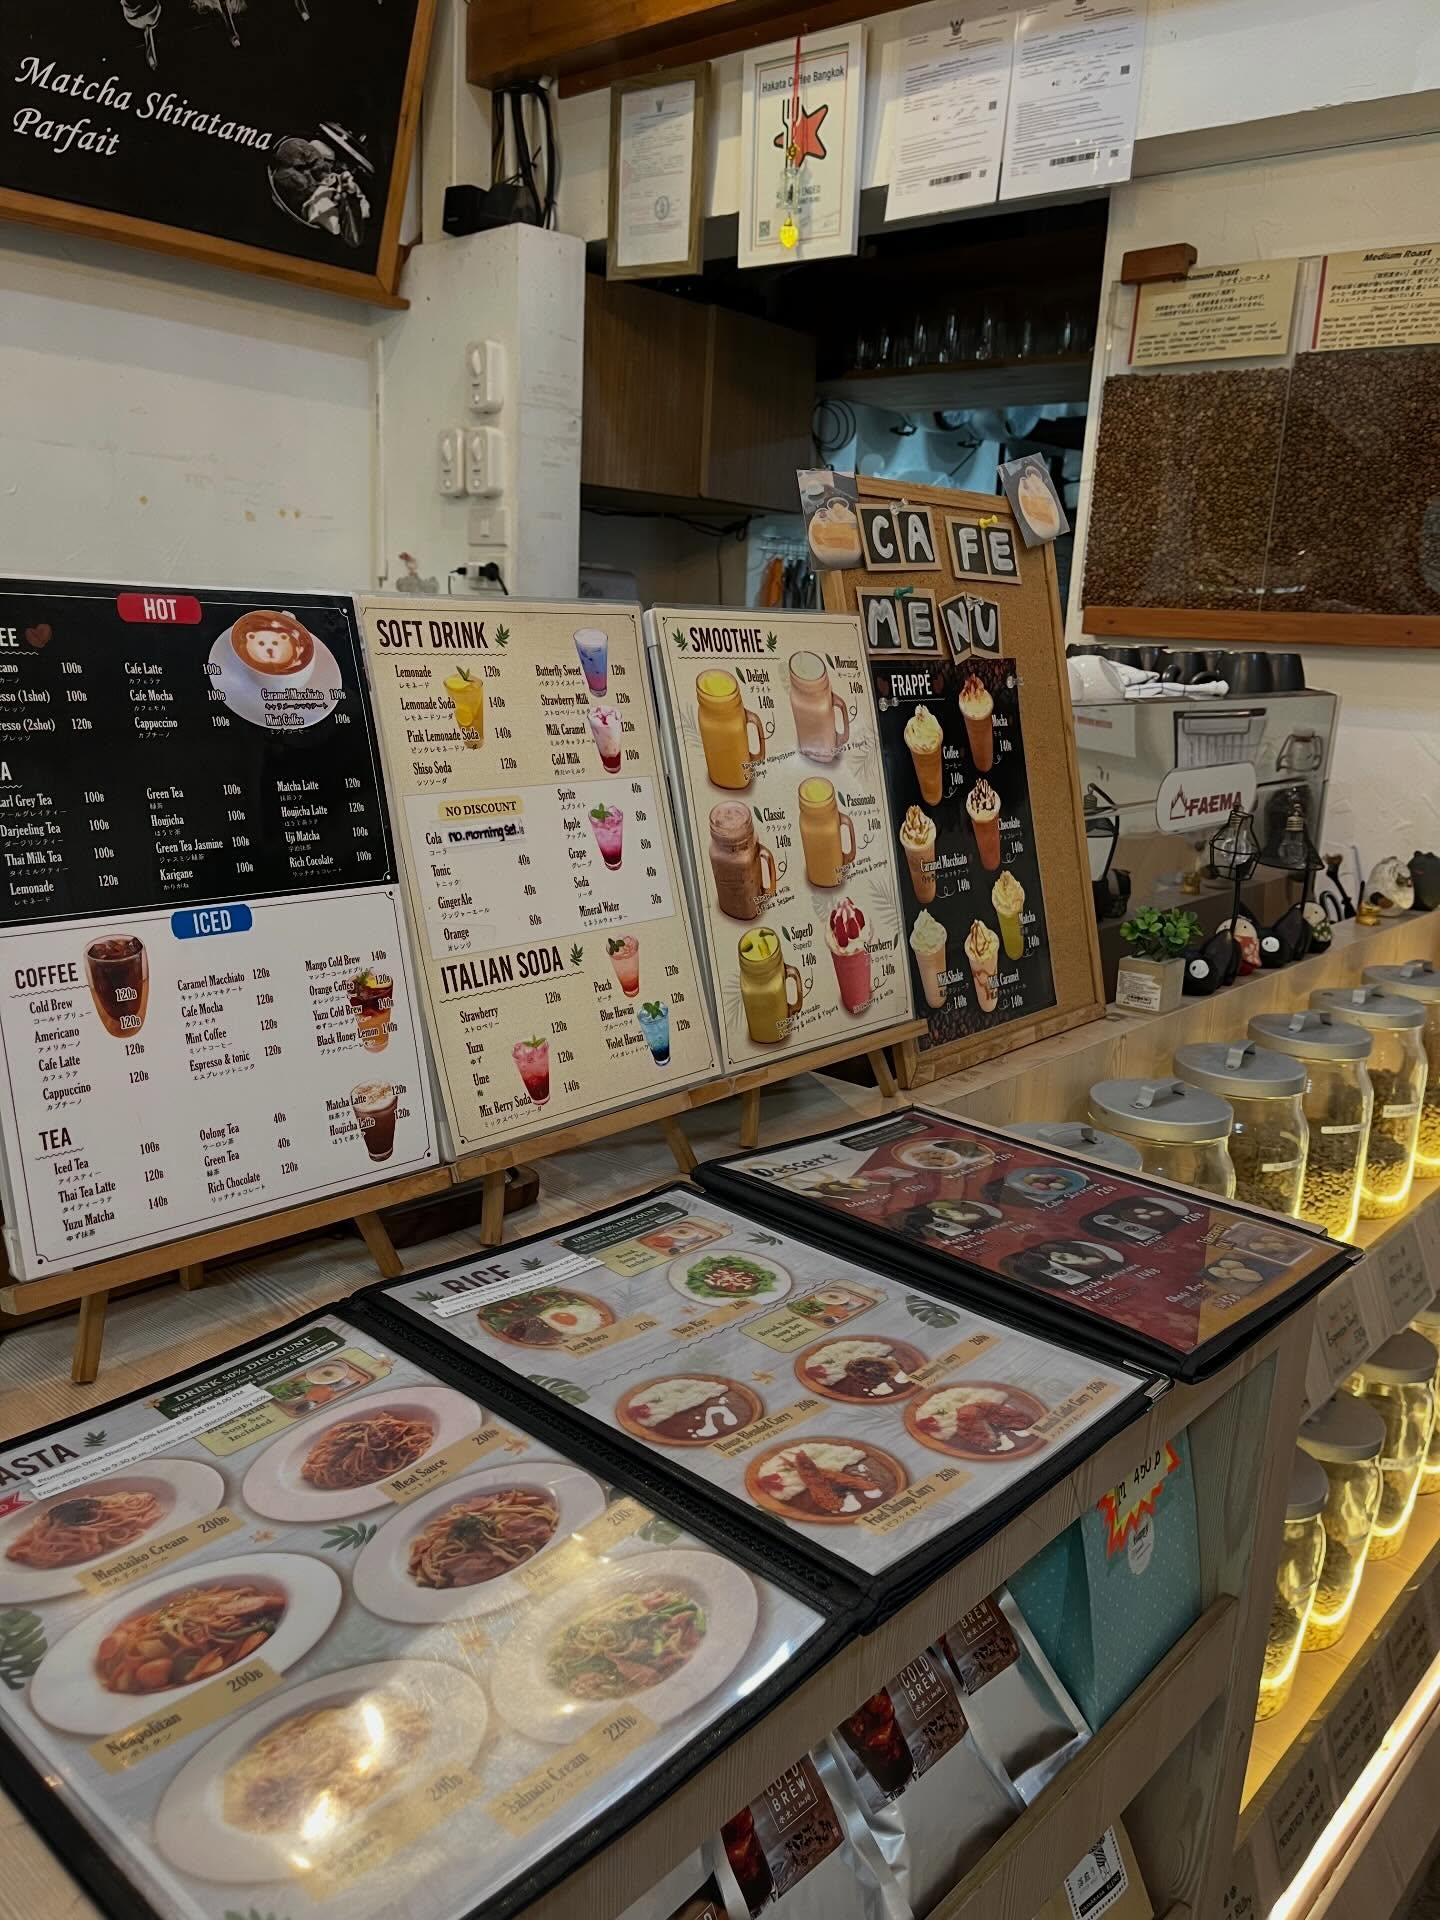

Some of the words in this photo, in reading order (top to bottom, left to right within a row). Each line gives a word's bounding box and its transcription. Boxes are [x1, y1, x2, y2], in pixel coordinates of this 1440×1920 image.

[762, 80, 786, 92] Hakata
[788, 73, 811, 87] Cffee
[813, 66, 844, 81] Bangkok
[14, 56, 133, 111] Matcha
[136, 91, 274, 151] Shiratama
[12, 107, 121, 157] Parfait
[1403, 249, 1432, 259] Roast
[1216, 268, 1239, 279] Roast
[143, 598, 177, 620] HOT
[377, 619, 423, 648] SOFT
[429, 621, 489, 649] DRINK
[689, 627, 765, 654] SMOOTHIE
[125, 662, 142, 675] Cafe
[143, 662, 162, 675] Latte
[394, 664, 432, 678] Lemonade
[834, 655, 859, 670] Morning
[535, 665, 562, 678] Butterfly
[563, 665, 582, 676] Sweet
[745, 669, 770, 684] Delight
[891, 670, 933, 697] FRAPPÉ
[129, 690, 147, 701] Cafe
[149, 690, 173, 701] Mocha
[540, 694, 575, 706] Strawberry
[134, 717, 178, 731] Cappuccino
[991, 714, 1008, 727] Mocha
[407, 730, 424, 743] Pink
[425, 729, 461, 742] Lemonade
[462, 728, 479, 740] Soda
[943, 746, 959, 759] Coffee
[147, 788, 169, 800] Green
[170, 787, 184, 798] Tea
[277, 780, 301, 792] Matcha
[302, 780, 319, 791] Latte
[15, 794, 36, 808] Grey
[37, 793, 52, 806] Tea
[557, 788, 576, 802] Sprite
[445, 806, 461, 816] NO
[463, 801, 516, 815] DISCOUNT
[1188, 791, 1243, 817] FAEMA
[150, 814, 184, 828] Houjicha
[763, 807, 785, 823] Classic
[0, 823, 45, 839] Darjeeling
[45, 822, 61, 834] Tea
[563, 818, 581, 831] Apple
[156, 842, 178, 854] Green
[179, 840, 193, 851] Tea
[194, 838, 224, 851] Jasmine
[425, 833, 442, 845] Cola
[5, 853, 25, 866] Thai
[26, 851, 47, 864] Milk
[47, 850, 62, 863] Tea
[568, 847, 587, 860] Grape
[159, 869, 193, 882] Karigane
[431, 864, 451, 877] Tonic
[9, 881, 54, 896] Lemonade
[578, 903, 602, 918] Mineral
[602, 901, 620, 913] Water
[192, 909, 232, 935] ICED
[443, 927, 470, 941] Orange
[790, 923, 813, 940] SuperD
[863, 939, 893, 955] Strawberry
[305, 959, 327, 972] Mango
[328, 957, 343, 967] Cold
[344, 955, 360, 964] Brew
[440, 953, 514, 994] ITALIAN
[515, 945, 564, 980] SODA
[14, 962, 79, 990] COFFEE
[177, 978, 209, 991] Caramel
[209, 973, 245, 988] Macchiato
[309, 984, 333, 998] Orange
[333, 981, 354, 993] Coffee
[29, 1000, 50, 1014] Cold
[51, 999, 73, 1011] Brew
[459, 1006, 499, 1024] Strawberry
[34, 1027, 80, 1044] Americano
[185, 1033, 203, 1044] Mint
[203, 1029, 227, 1041] Coffee
[316, 1034, 336, 1047] Black
[336, 1031, 357, 1044] Honey
[357, 1027, 379, 1038] Lemon
[38, 1057, 58, 1072] Cafe
[59, 1055, 81, 1067] Latte
[189, 1059, 223, 1073] Espresso
[224, 1054, 231, 1065] &
[232, 1052, 250, 1064] tonic
[42, 1082, 91, 1101] Cappuccino
[478, 1105, 494, 1119] Mix
[494, 1099, 514, 1116] Berry
[514, 1094, 532, 1108] Soda
[39, 1127, 72, 1151] TEA
[199, 1126, 226, 1141] Oolong
[226, 1123, 240, 1135] Tea
[54, 1160, 73, 1175] Iced
[74, 1157, 89, 1171] Tea
[751, 1153, 838, 1178] Dessert
[207, 1179, 225, 1194] Rich
[226, 1172, 261, 1189] Chocolate
[58, 1189, 78, 1203] Thai
[80, 1185, 94, 1198] Tea
[95, 1181, 116, 1193] Latte
[62, 1218, 83, 1232] Yuzu
[84, 1210, 115, 1226] Matcha
[440, 1264, 512, 1294] RICE
[174, 1378, 223, 1402] DRINK
[222, 1367, 247, 1383] 50%
[245, 1335, 312, 1371] DISCOUNT
[221, 1420, 250, 1436] Soup
[250, 1414, 266, 1424] Set
[768, 1413, 793, 1425] Curry
[229, 1419, 273, 1442] Included
[416, 1459, 447, 1477] Sauce
[863, 1509, 889, 1526] Fried
[907, 1484, 936, 1498] Curry
[91, 1546, 151, 1584] Mentaiko
[148, 1533, 190, 1558] Cream
[960, 1602, 989, 1629] BREW
[900, 1654, 931, 1687] COLD
[908, 1673, 938, 1702] BREW
[104, 1711, 182, 1756] Neapolitan
[502, 1779, 551, 1817] Salmon
[545, 1751, 591, 1784] Cream
[771, 1779, 808, 1812] BREW
